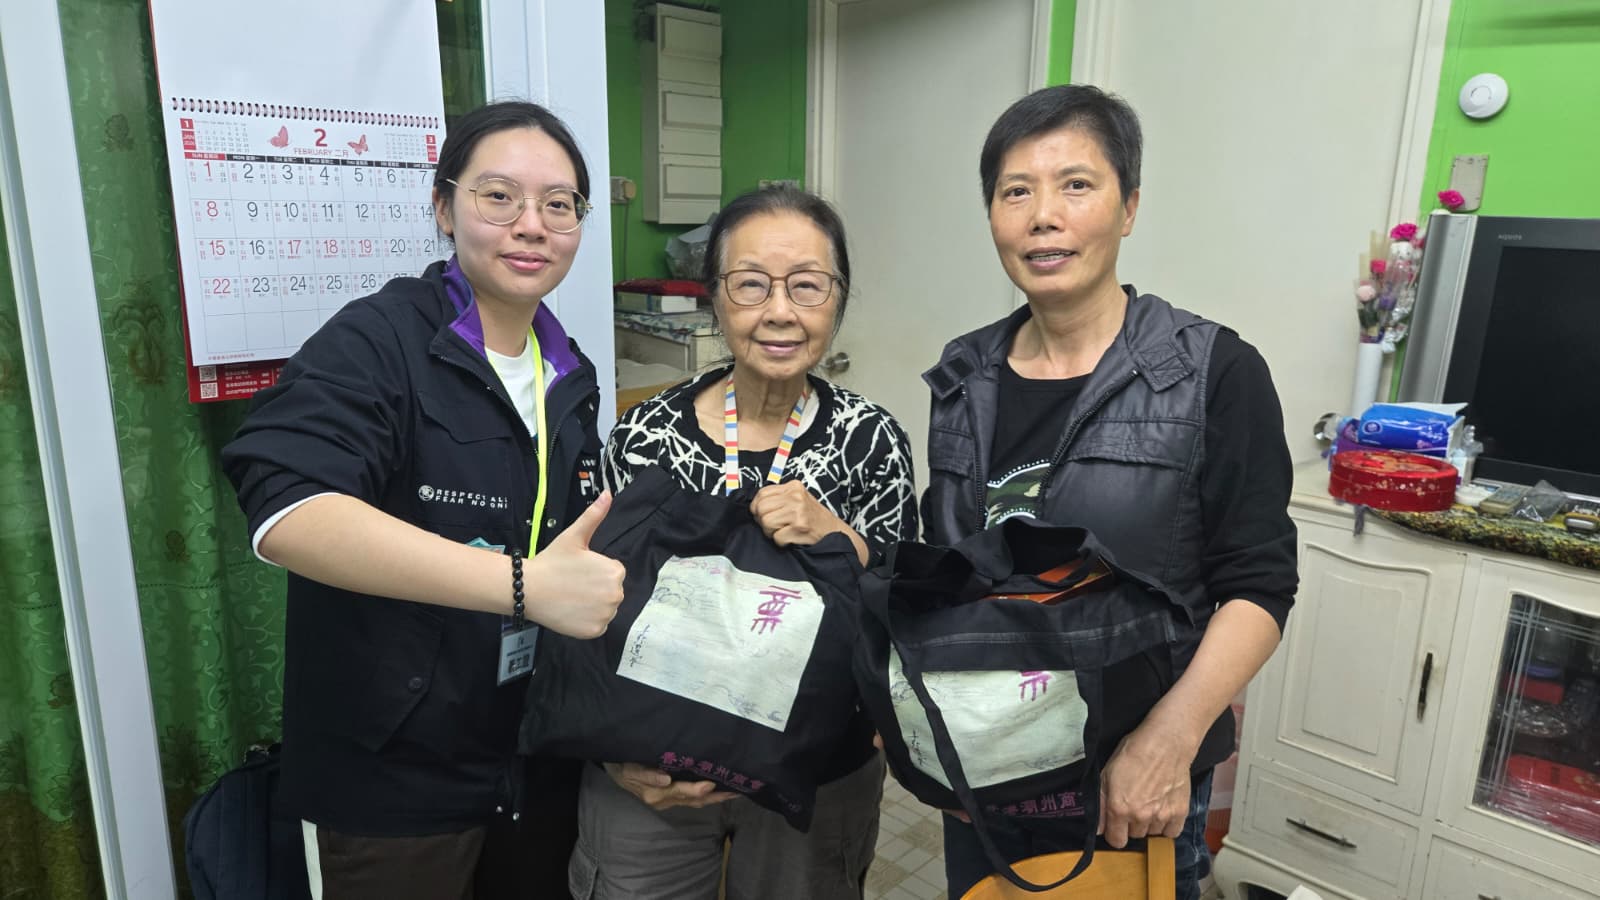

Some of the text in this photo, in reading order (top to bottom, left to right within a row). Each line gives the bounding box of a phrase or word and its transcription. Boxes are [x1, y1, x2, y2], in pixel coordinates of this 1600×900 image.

[313, 128, 328, 147] 2
[293, 148, 349, 158] FEBRUARY 二月
[203, 162, 212, 177] 1
[243, 163, 254, 179] 2
[282, 165, 294, 180] 3
[319, 166, 330, 180] 4
[354, 168, 364, 183] 5
[387, 169, 397, 184] 6
[419, 170, 428, 184] 7
[207, 201, 433, 218] 8 9 10 11 12 13 14
[210, 239, 435, 255] 15 16 17 18 19 20 21
[213, 279, 230, 294] 22
[252, 277, 270, 292] 23
[290, 276, 306, 291] 24
[327, 275, 342, 289] 25
[361, 274, 376, 288] 26
[435, 495, 464, 504] FEAR
[436, 489, 486, 500] RESPECT
